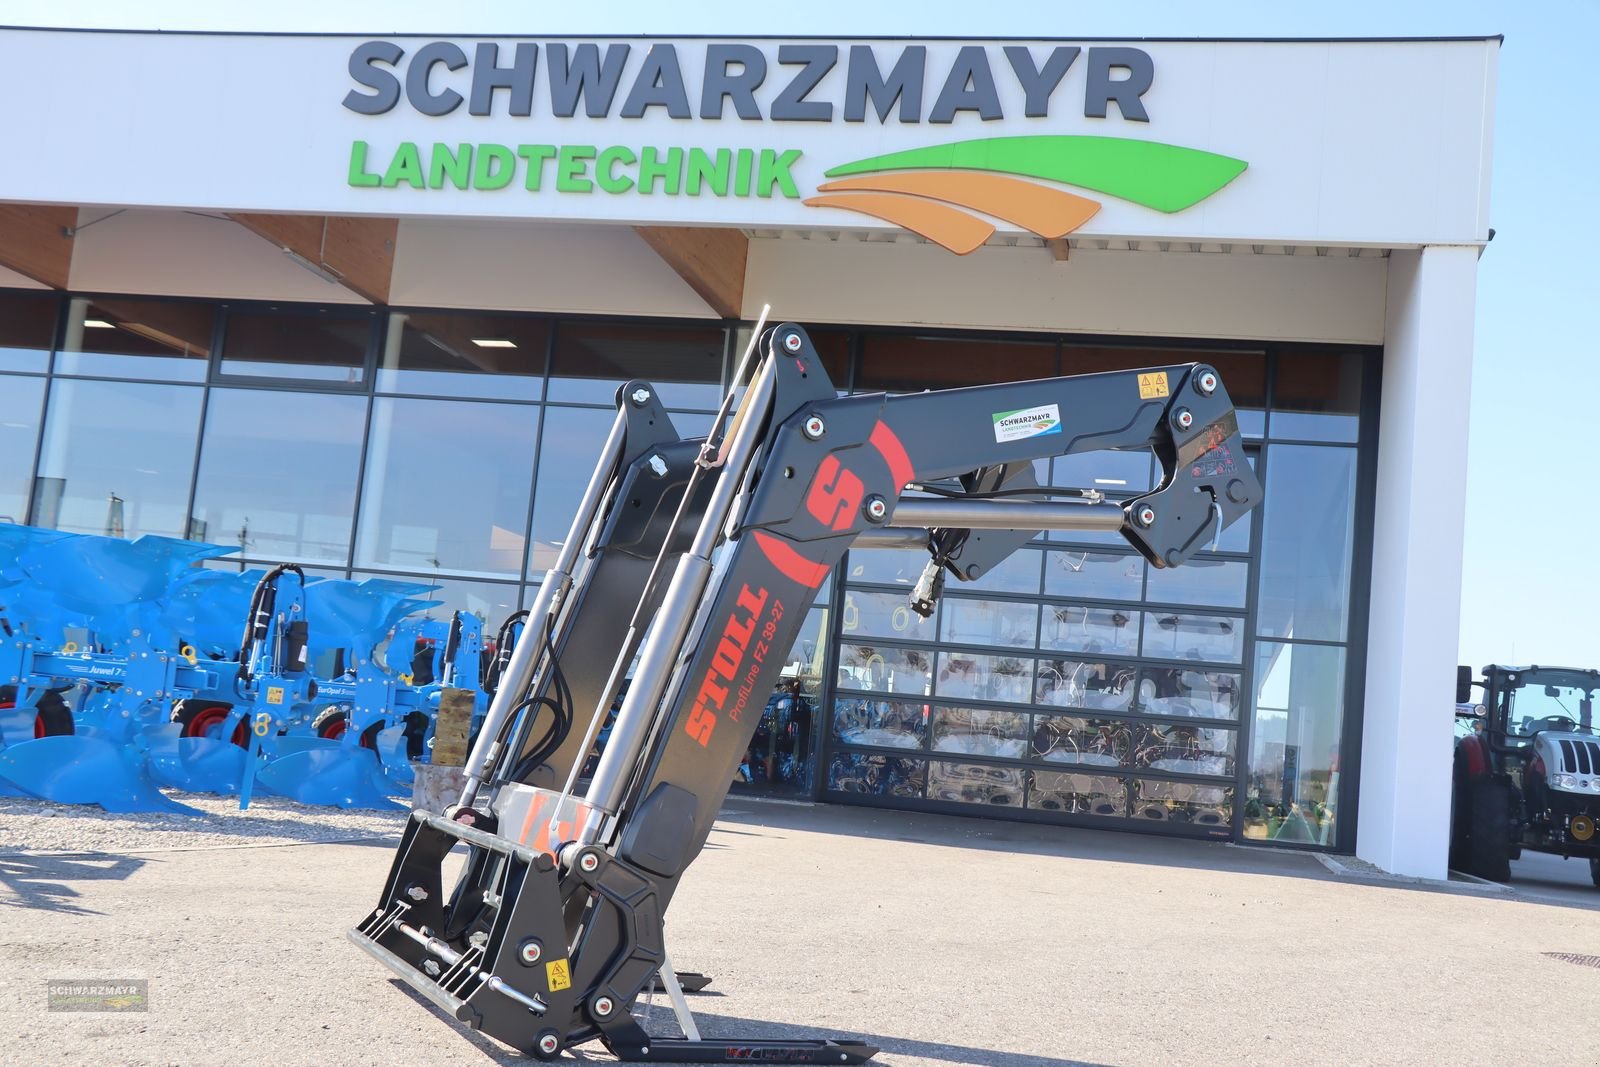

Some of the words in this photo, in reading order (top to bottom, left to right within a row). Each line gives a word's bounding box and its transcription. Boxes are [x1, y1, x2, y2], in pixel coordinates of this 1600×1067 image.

[341, 41, 1155, 124] SCHWARZMAYR
[348, 140, 803, 198] LANDTECHNIK
[1000, 413, 1050, 427] SCHWARZMAYR
[88, 665, 115, 676] Juwel
[114, 668, 122, 676] 7
[685, 583, 769, 747] STOLL
[729, 664, 760, 722] ProfiLine
[753, 640, 769, 664] FZ
[762, 599, 785, 641] 39-27
